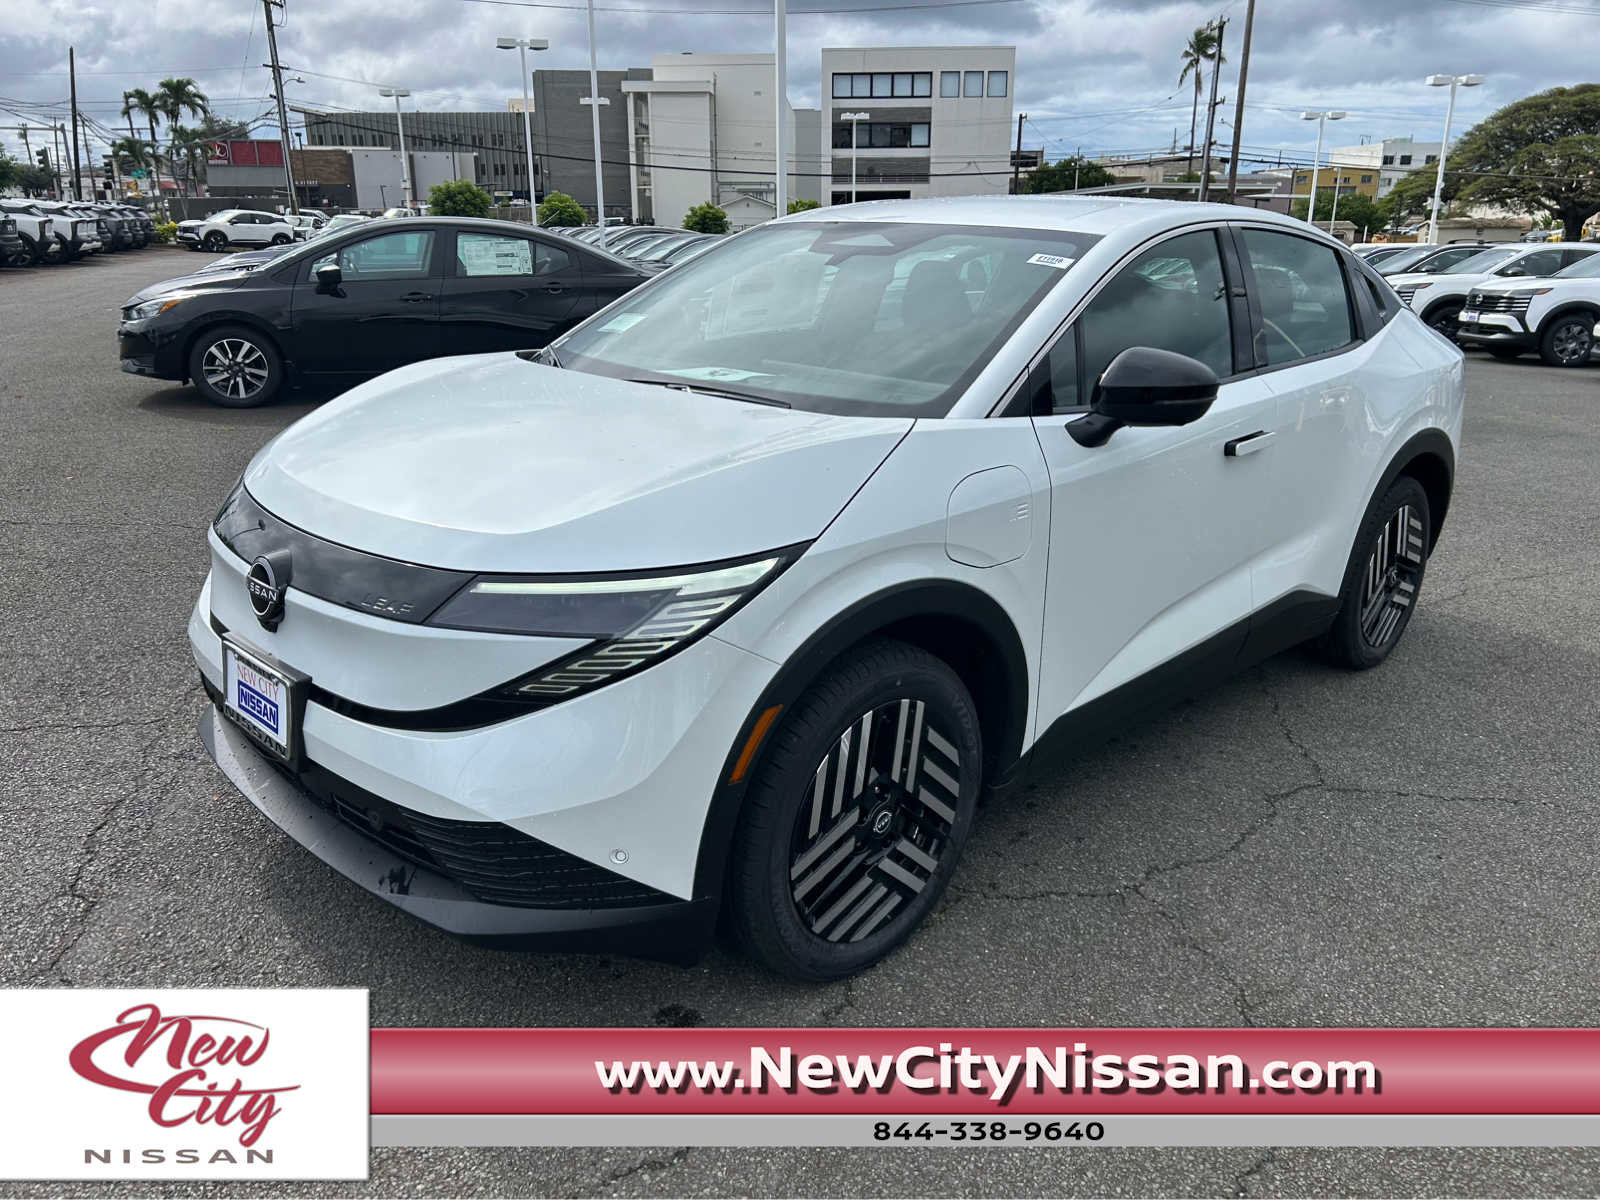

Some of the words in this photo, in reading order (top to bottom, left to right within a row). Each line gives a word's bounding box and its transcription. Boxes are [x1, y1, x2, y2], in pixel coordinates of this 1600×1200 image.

[249, 581, 277, 601] SSAN
[237, 663, 257, 687] NEW
[259, 675, 279, 702] CITY
[240, 687, 277, 727] NISSAN
